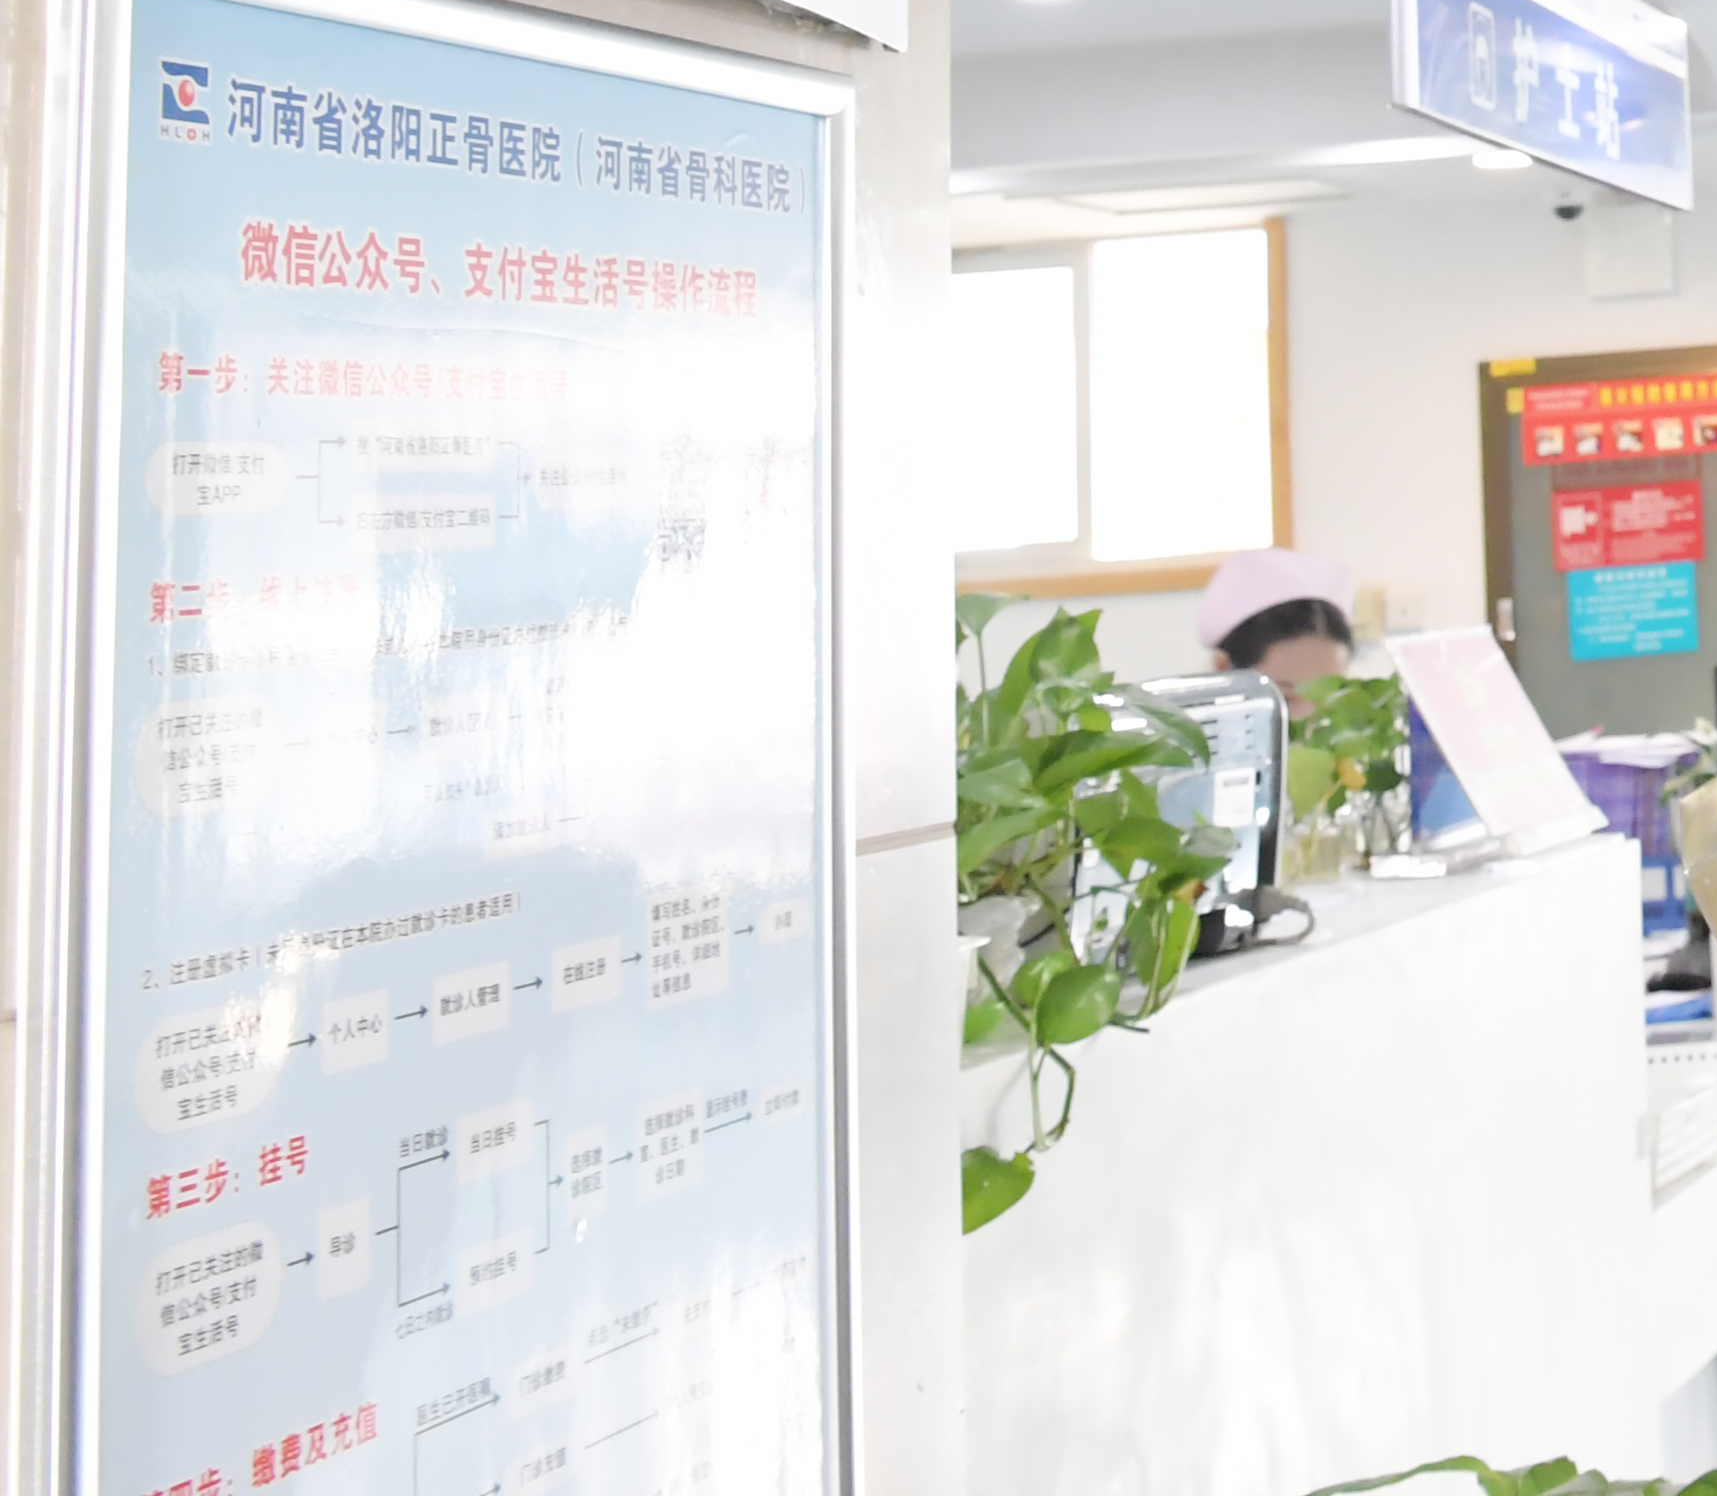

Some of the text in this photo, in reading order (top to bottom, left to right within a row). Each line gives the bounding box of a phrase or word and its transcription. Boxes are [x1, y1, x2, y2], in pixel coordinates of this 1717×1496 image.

[440, 983, 501, 1016] 就诊人管理
[328, 1013, 383, 1045] 个人中心
[177, 1084, 238, 1120] 宝生活号
[400, 1124, 449, 1158] 当日就诊
[470, 1120, 517, 1154] 当日挂号
[177, 1314, 239, 1357] 宝生活号
